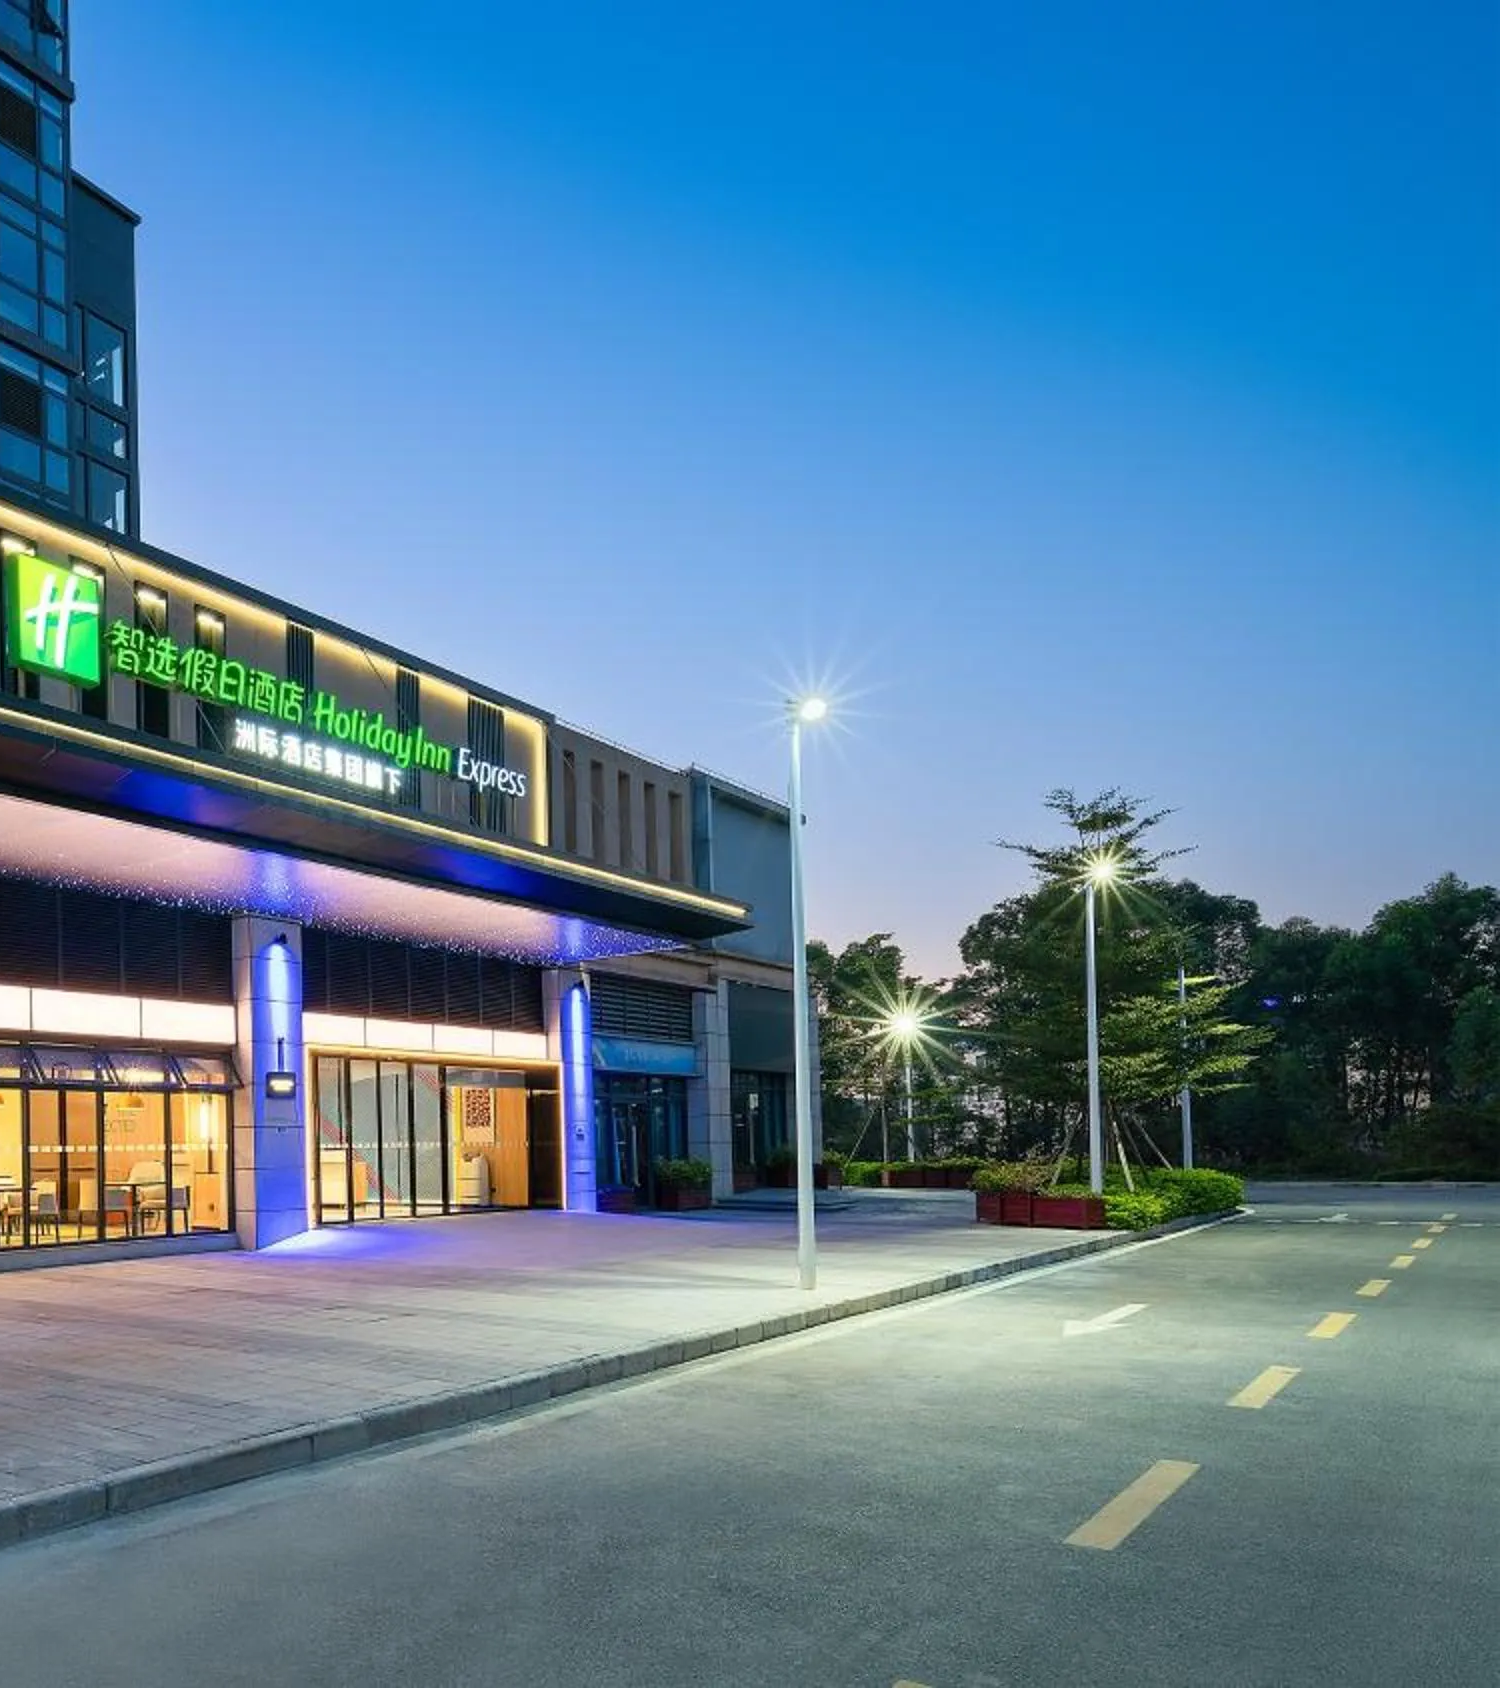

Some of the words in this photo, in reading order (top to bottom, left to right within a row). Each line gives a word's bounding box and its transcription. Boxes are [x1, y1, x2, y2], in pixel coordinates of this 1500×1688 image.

[104, 619, 304, 725] 智选假日酒店
[314, 690, 412, 769] Holiday
[415, 726, 450, 773] Inn
[457, 746, 527, 797] Express
